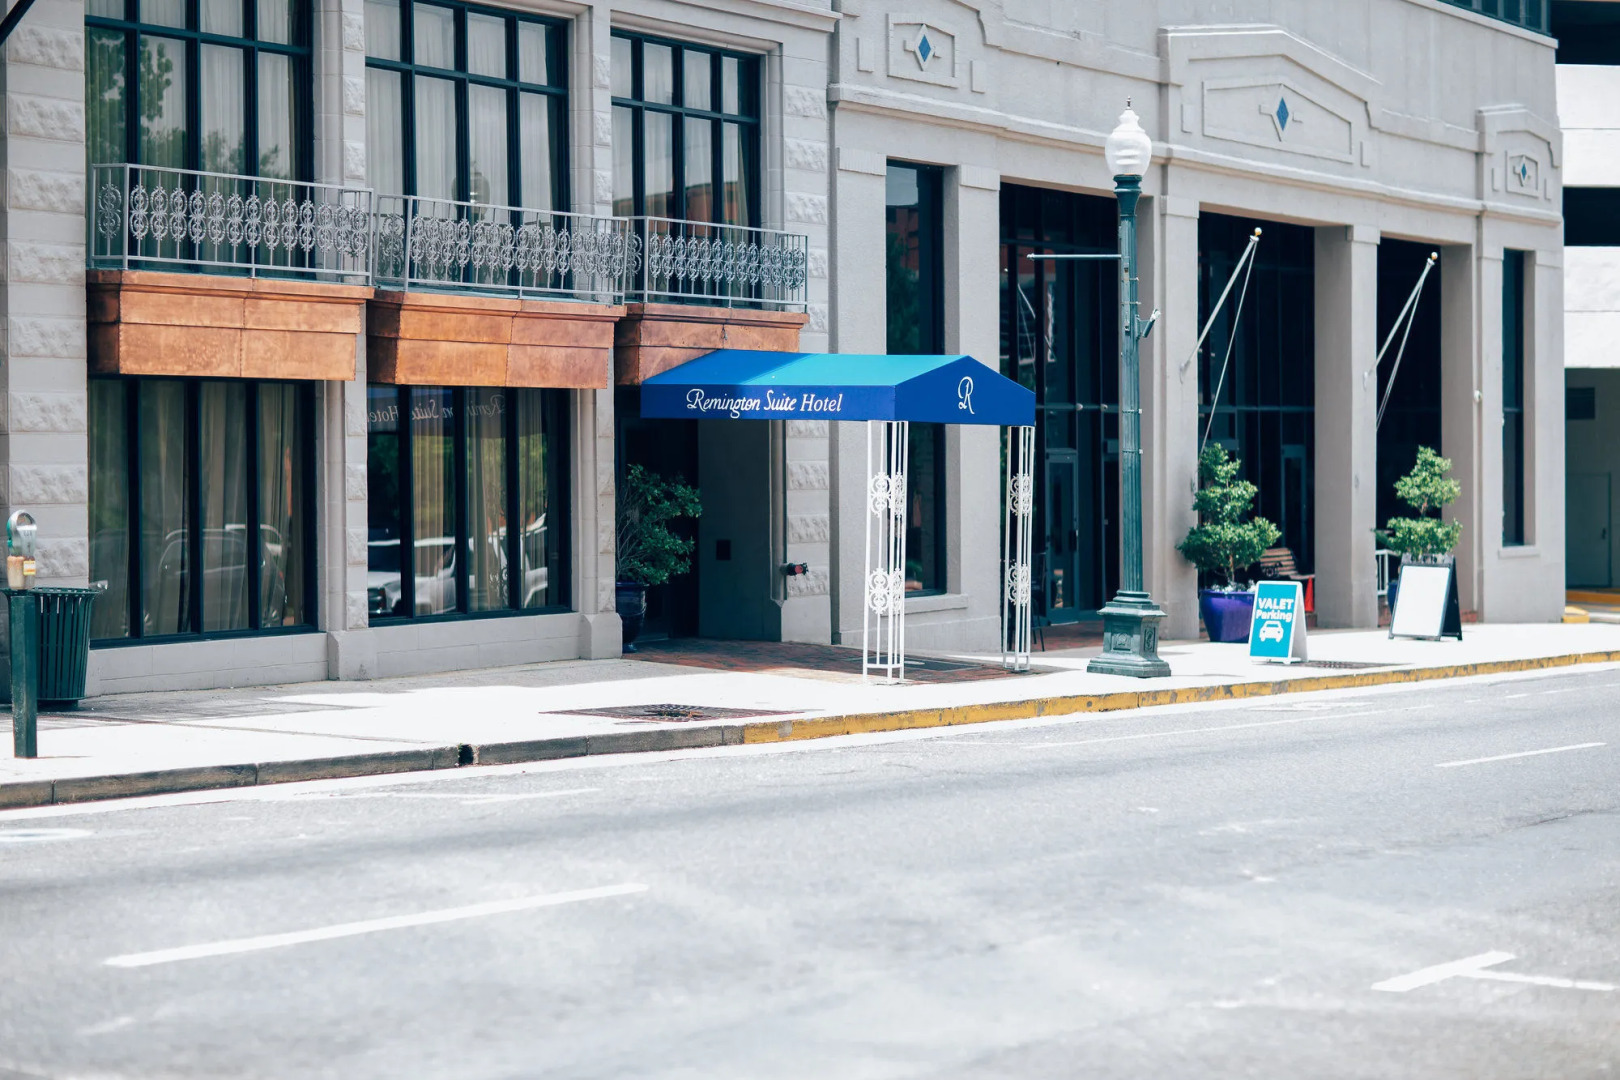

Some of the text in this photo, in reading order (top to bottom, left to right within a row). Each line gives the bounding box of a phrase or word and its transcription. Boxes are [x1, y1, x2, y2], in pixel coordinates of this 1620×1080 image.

[686, 388, 843, 419] Remington Suite Hotel
[957, 376, 975, 414] R
[1258, 598, 1294, 610] VALET
[1256, 609, 1293, 622] Parking
